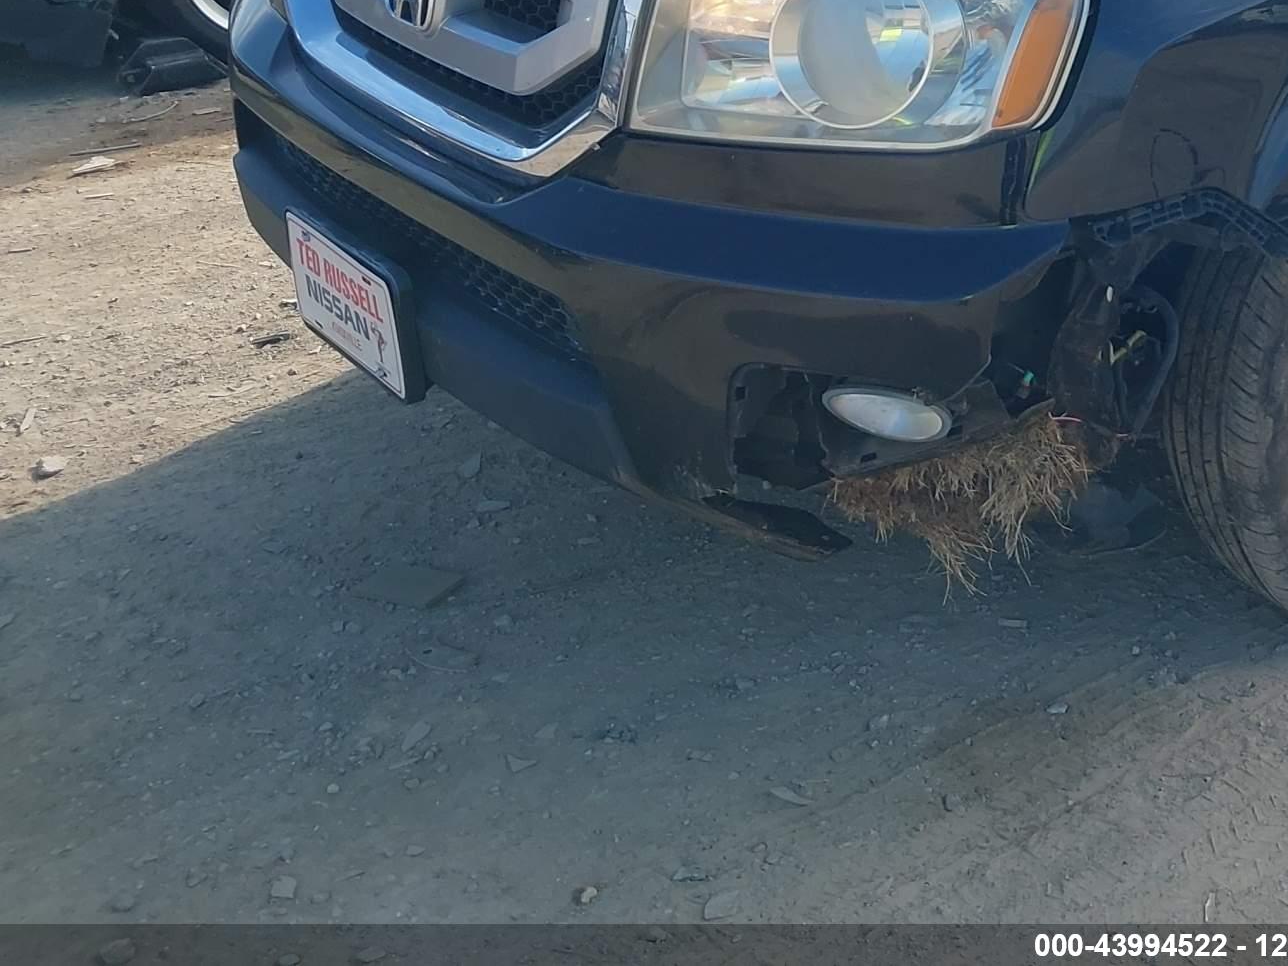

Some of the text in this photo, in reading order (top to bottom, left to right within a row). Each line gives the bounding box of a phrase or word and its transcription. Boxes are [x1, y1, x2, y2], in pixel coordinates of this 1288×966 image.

[296, 237, 384, 324] TED RUSSELL
[305, 273, 371, 341] NISSAN
